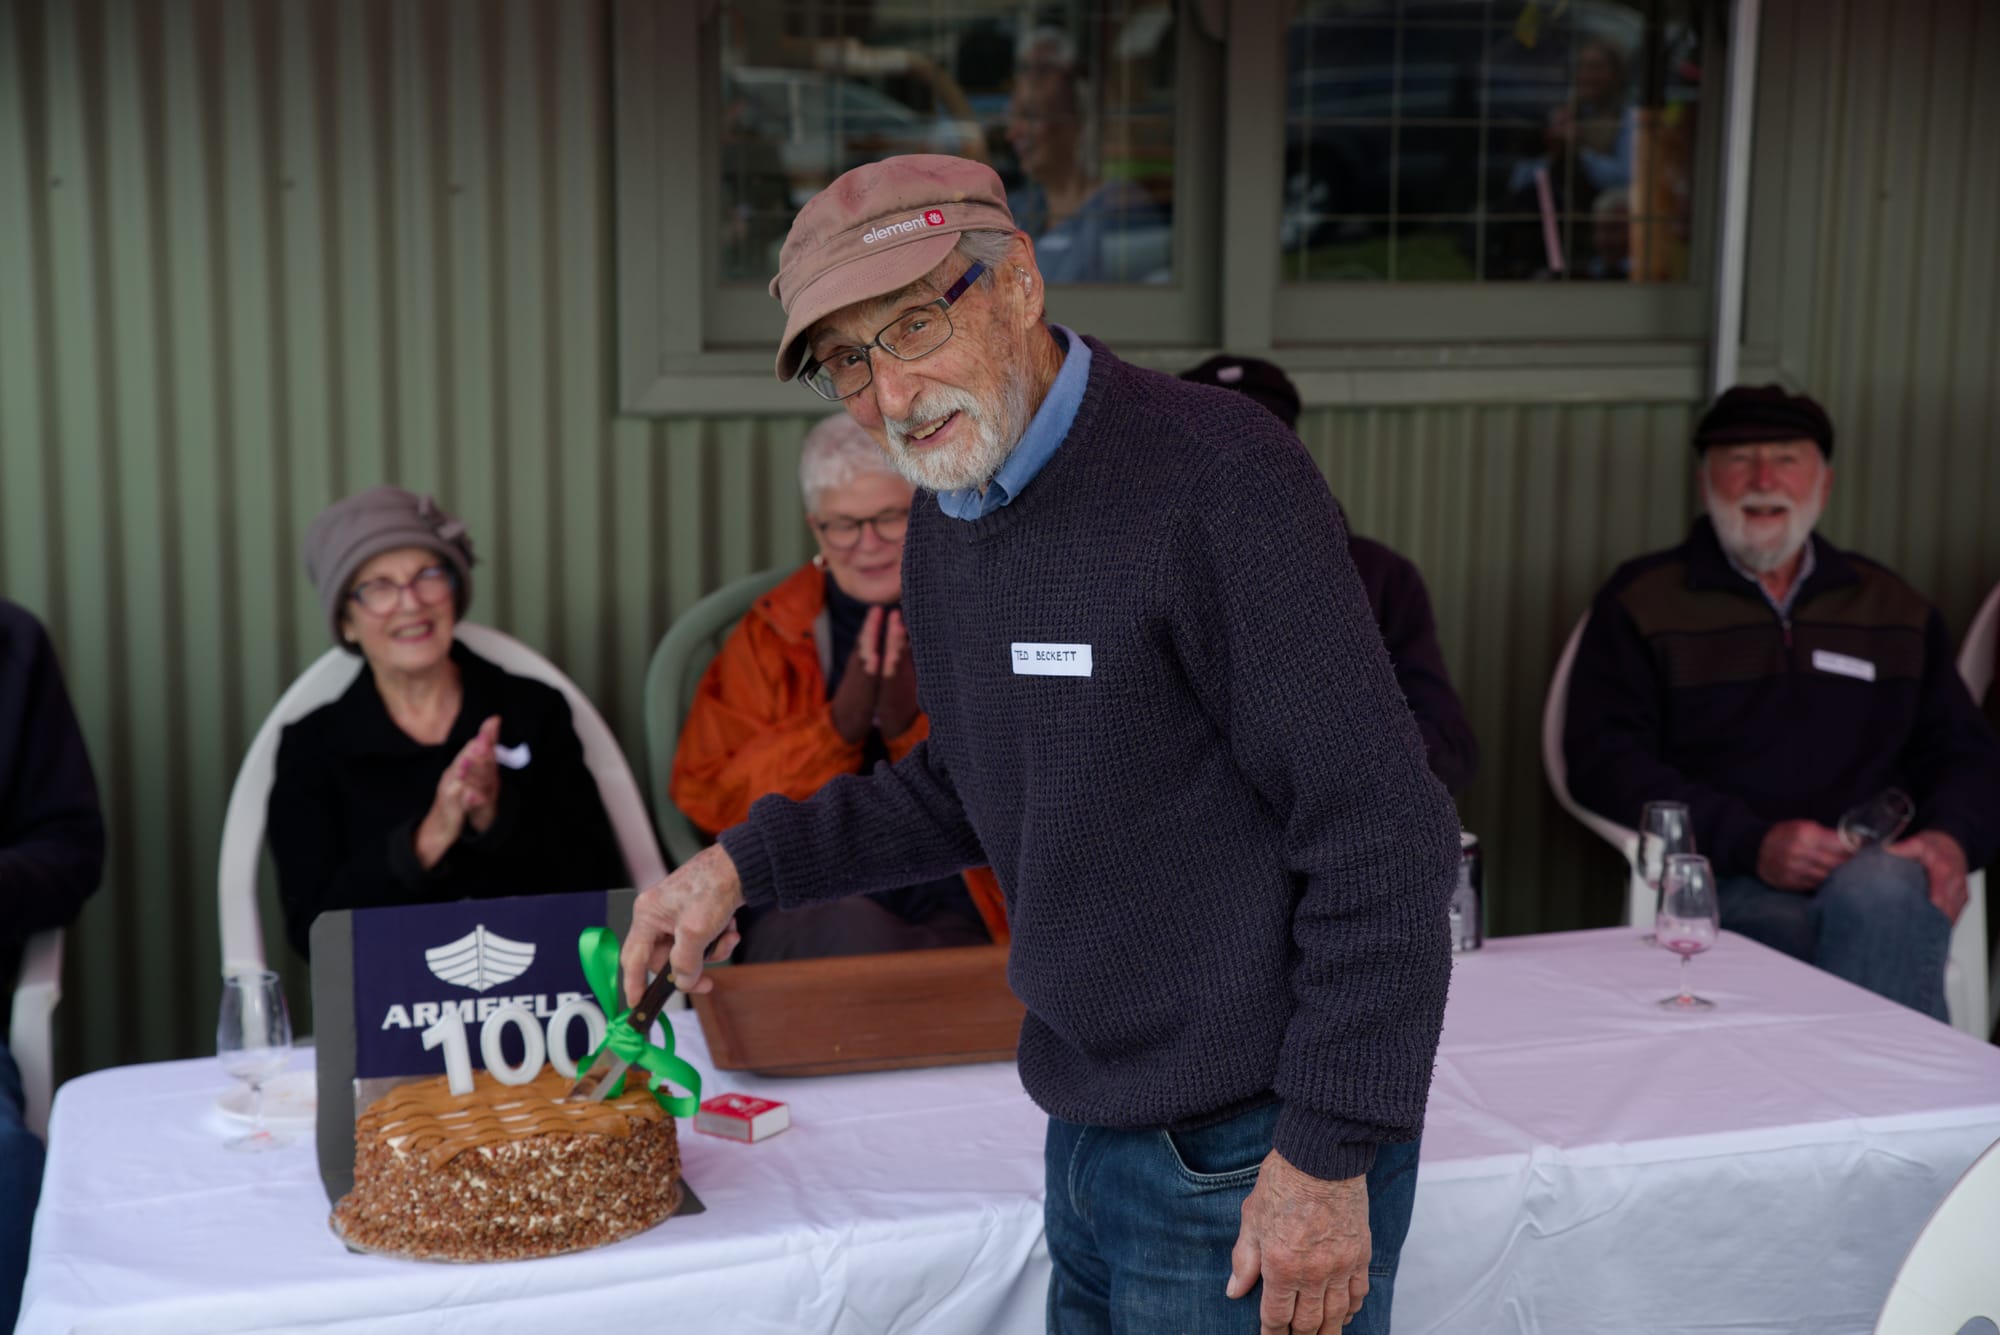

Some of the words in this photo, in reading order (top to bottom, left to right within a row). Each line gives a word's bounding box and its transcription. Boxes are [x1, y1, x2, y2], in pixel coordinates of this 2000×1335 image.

[863, 214, 927, 244] element
[1014, 650, 1029, 661] TED
[1036, 650, 1077, 662] BECKETT
[421, 1000, 608, 1097] 100
